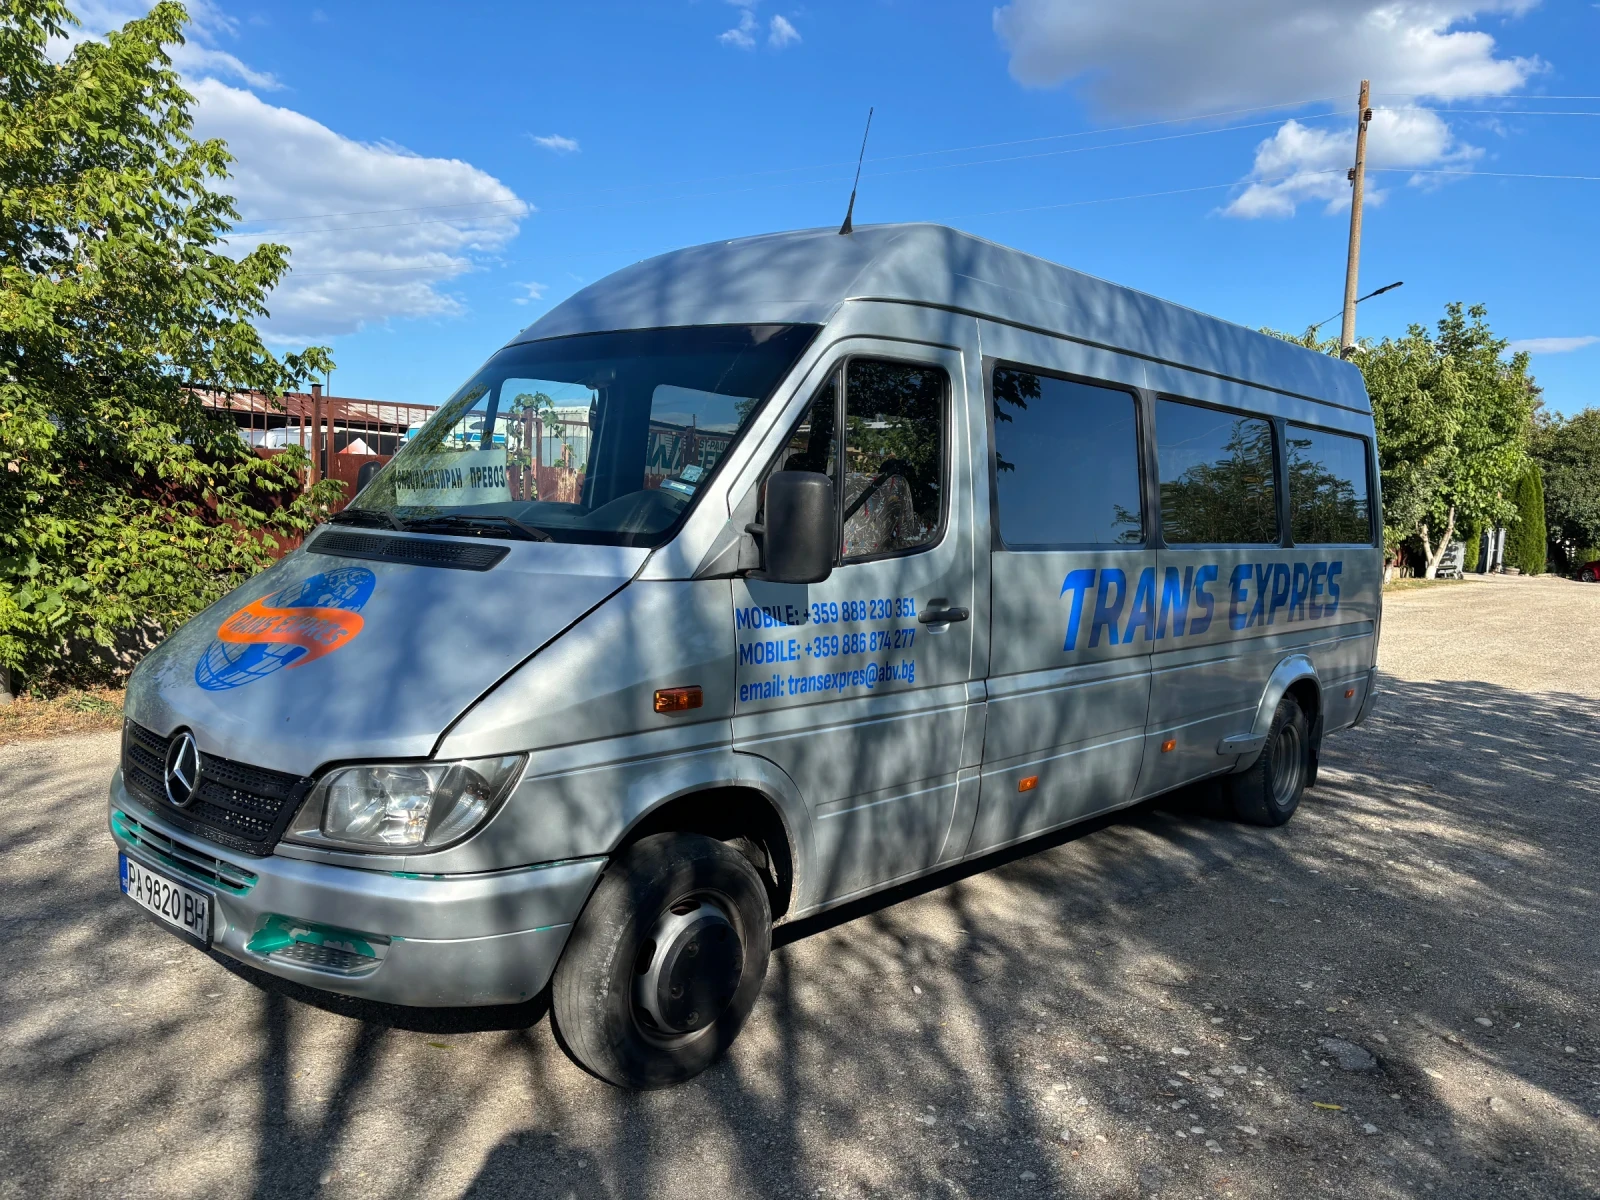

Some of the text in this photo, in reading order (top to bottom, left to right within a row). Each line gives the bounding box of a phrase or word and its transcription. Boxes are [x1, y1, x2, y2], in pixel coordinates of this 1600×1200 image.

[470, 465, 505, 488] ПРЕВОЗ
[736, 597, 916, 630] MOBILE: +359 888 230 351
[1059, 561, 1342, 651] TRANS EXPRES
[226, 612, 349, 645] TRANS EXPRES
[740, 628, 915, 666] MOBILE: +359 886 874 277
[740, 660, 914, 702] email: transexpres@abv.bg
